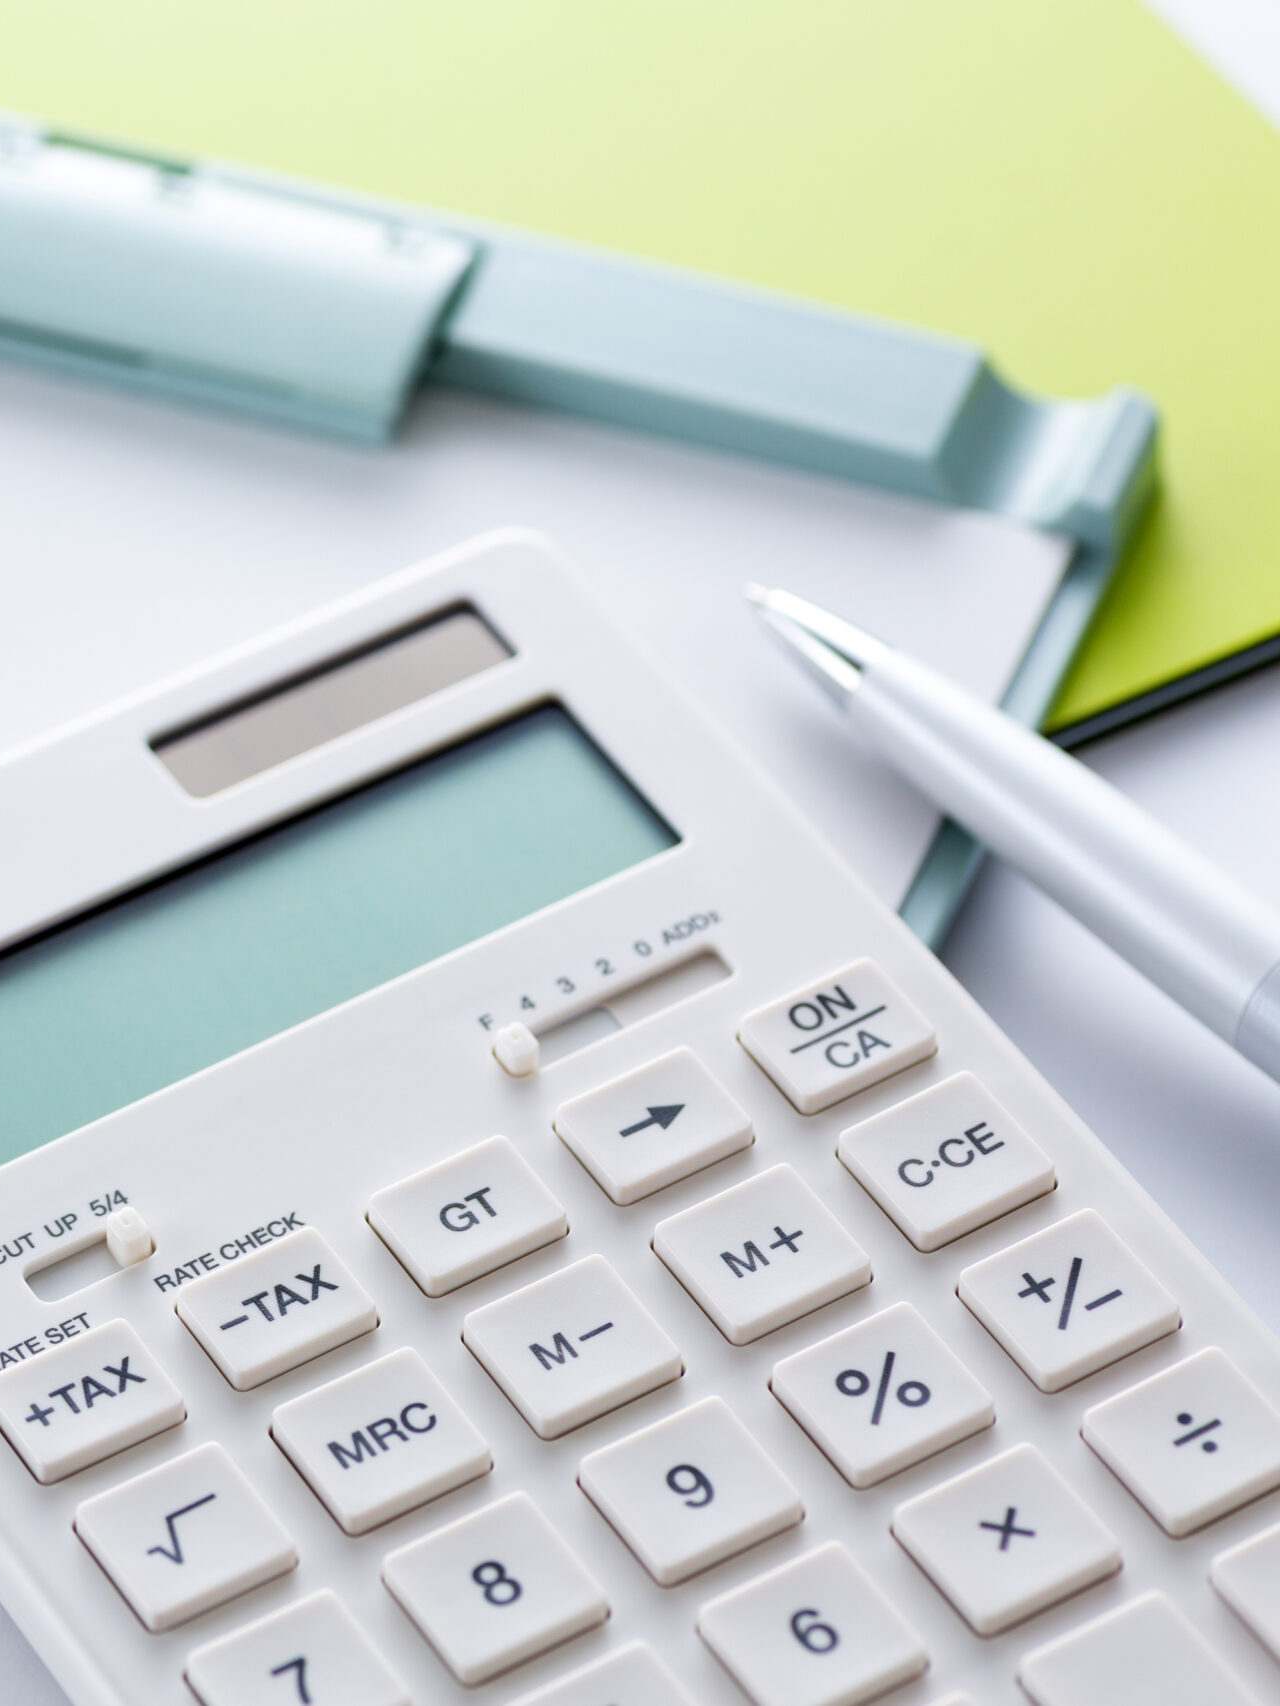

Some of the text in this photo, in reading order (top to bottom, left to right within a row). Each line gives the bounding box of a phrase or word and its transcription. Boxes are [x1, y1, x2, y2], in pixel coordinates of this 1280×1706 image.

[520, 994, 536, 1010] 4
[556, 976, 576, 994] 3
[595, 958, 615, 976] 2
[787, 984, 858, 1033] ON
[823, 1028, 892, 1069] CA
[43, 1212, 79, 1239] UP
[89, 1189, 129, 1218] 5/4
[439, 1186, 497, 1232] GT
[153, 1211, 306, 1293] RATE CHECK
[44, 1311, 92, 1345] SET
[835, 1351, 931, 1426] %
[327, 1402, 437, 1470] MRC
[665, 1463, 715, 1508] 9
[471, 1560, 523, 1607] 8
[789, 1608, 840, 1655] 6
[270, 1656, 311, 1705] 7
